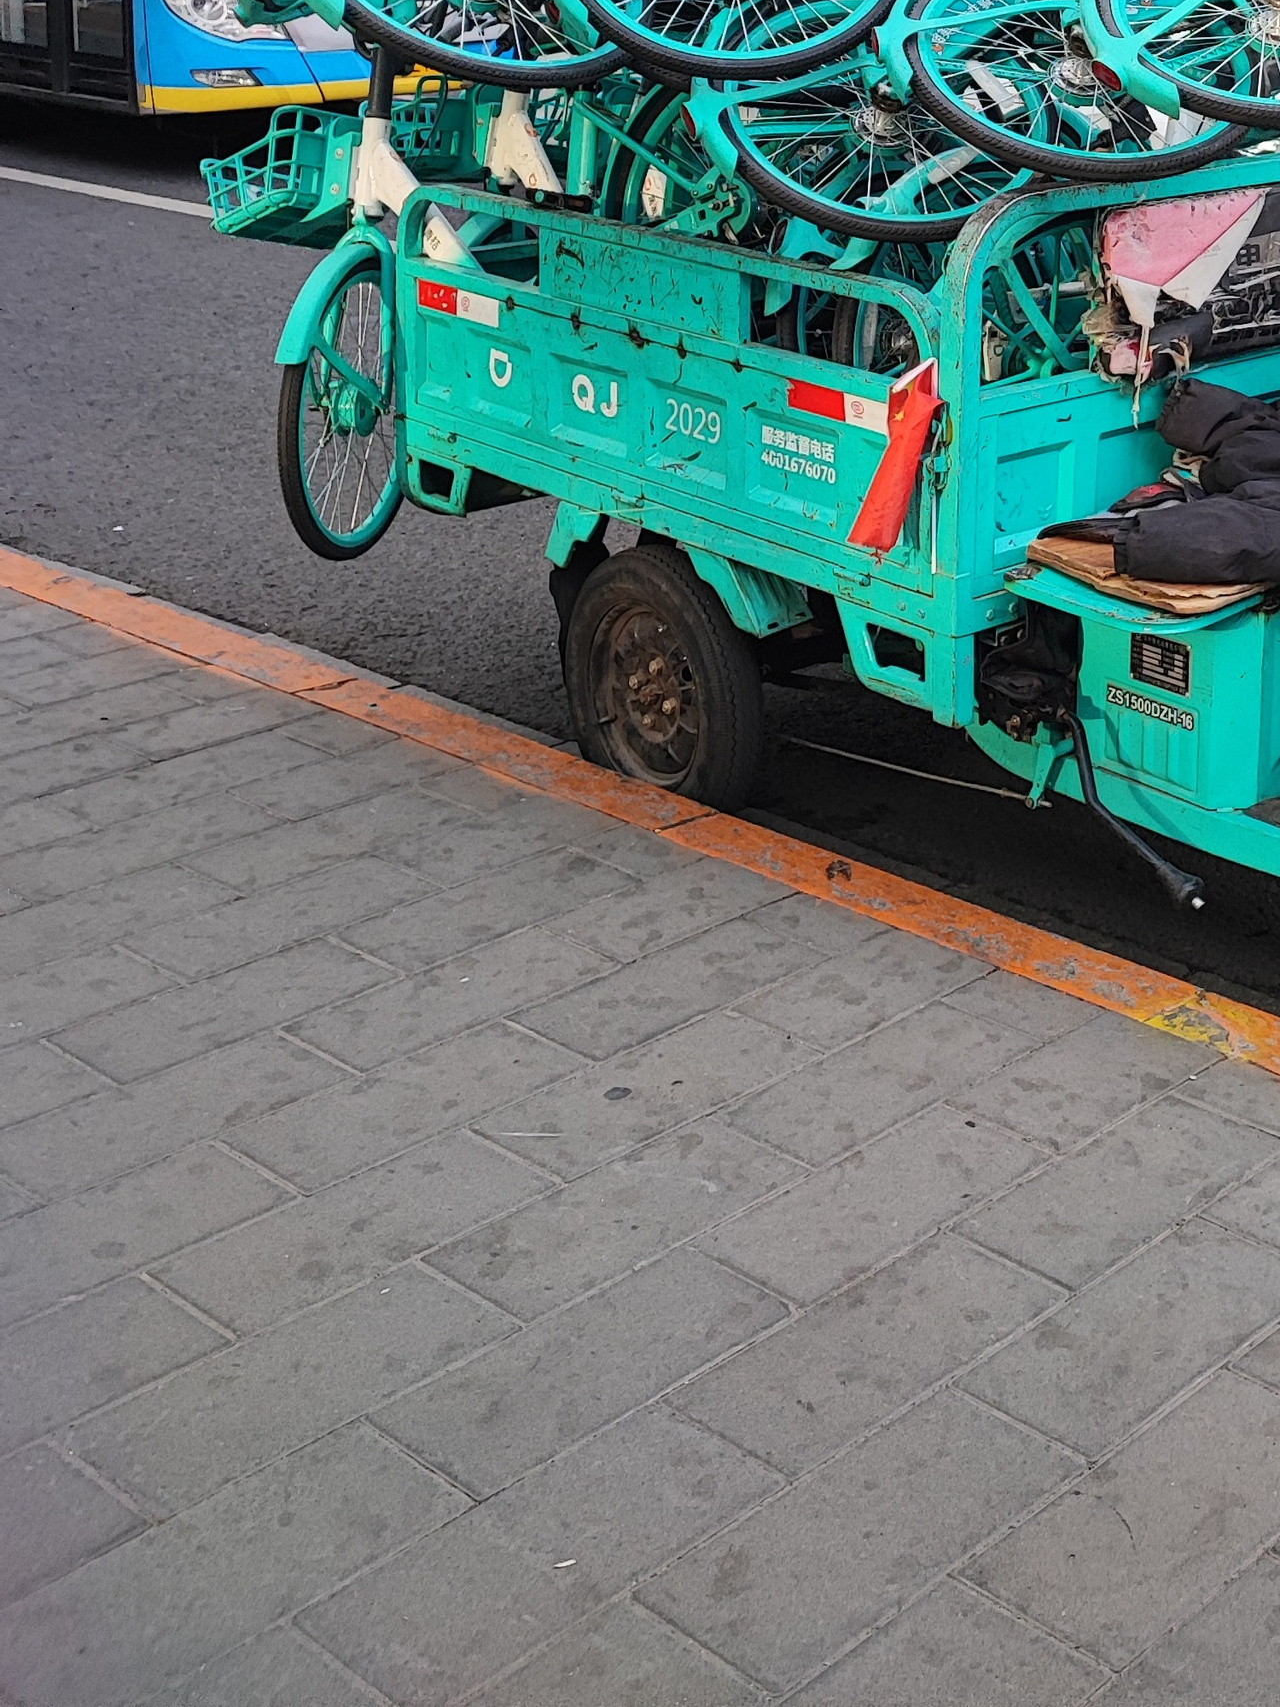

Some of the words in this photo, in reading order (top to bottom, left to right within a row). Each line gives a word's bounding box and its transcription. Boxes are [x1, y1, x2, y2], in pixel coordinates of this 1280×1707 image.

[572, 374, 619, 418] QJ
[664, 397, 721, 445] 2029
[761, 424, 835, 464] 服务监督电话
[761, 449, 837, 484] 4001676070
[1107, 686, 1194, 731] ZS1500DZH-16
